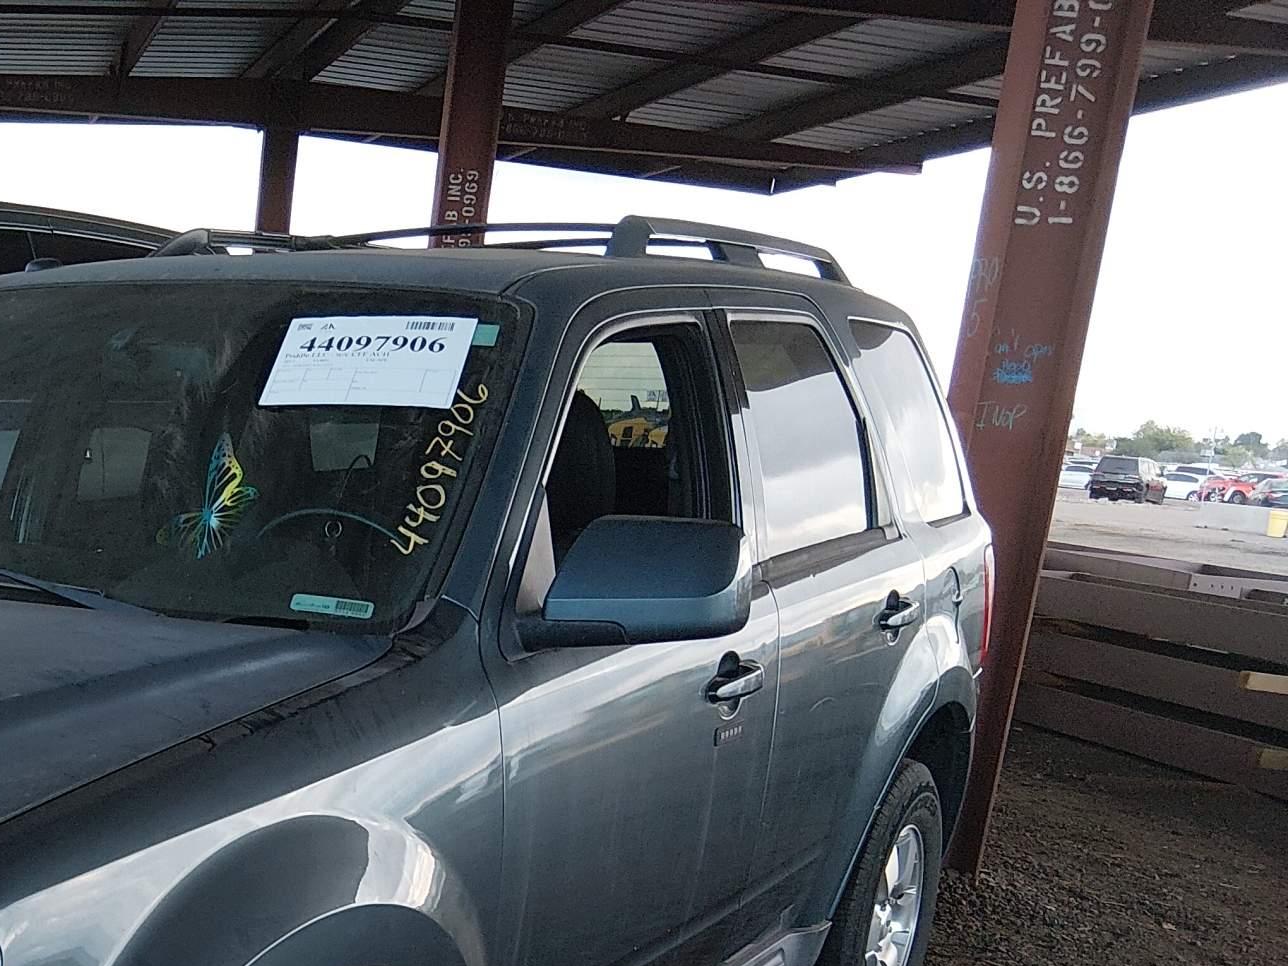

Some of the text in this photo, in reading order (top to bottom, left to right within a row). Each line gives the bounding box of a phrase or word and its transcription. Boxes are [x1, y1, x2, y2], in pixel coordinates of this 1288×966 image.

[1014, 0, 1080, 225] U.S. PREFAB
[447, 168, 463, 201] INC.
[299, 335, 448, 353] 44097906
[390, 383, 489, 556] 44097906
